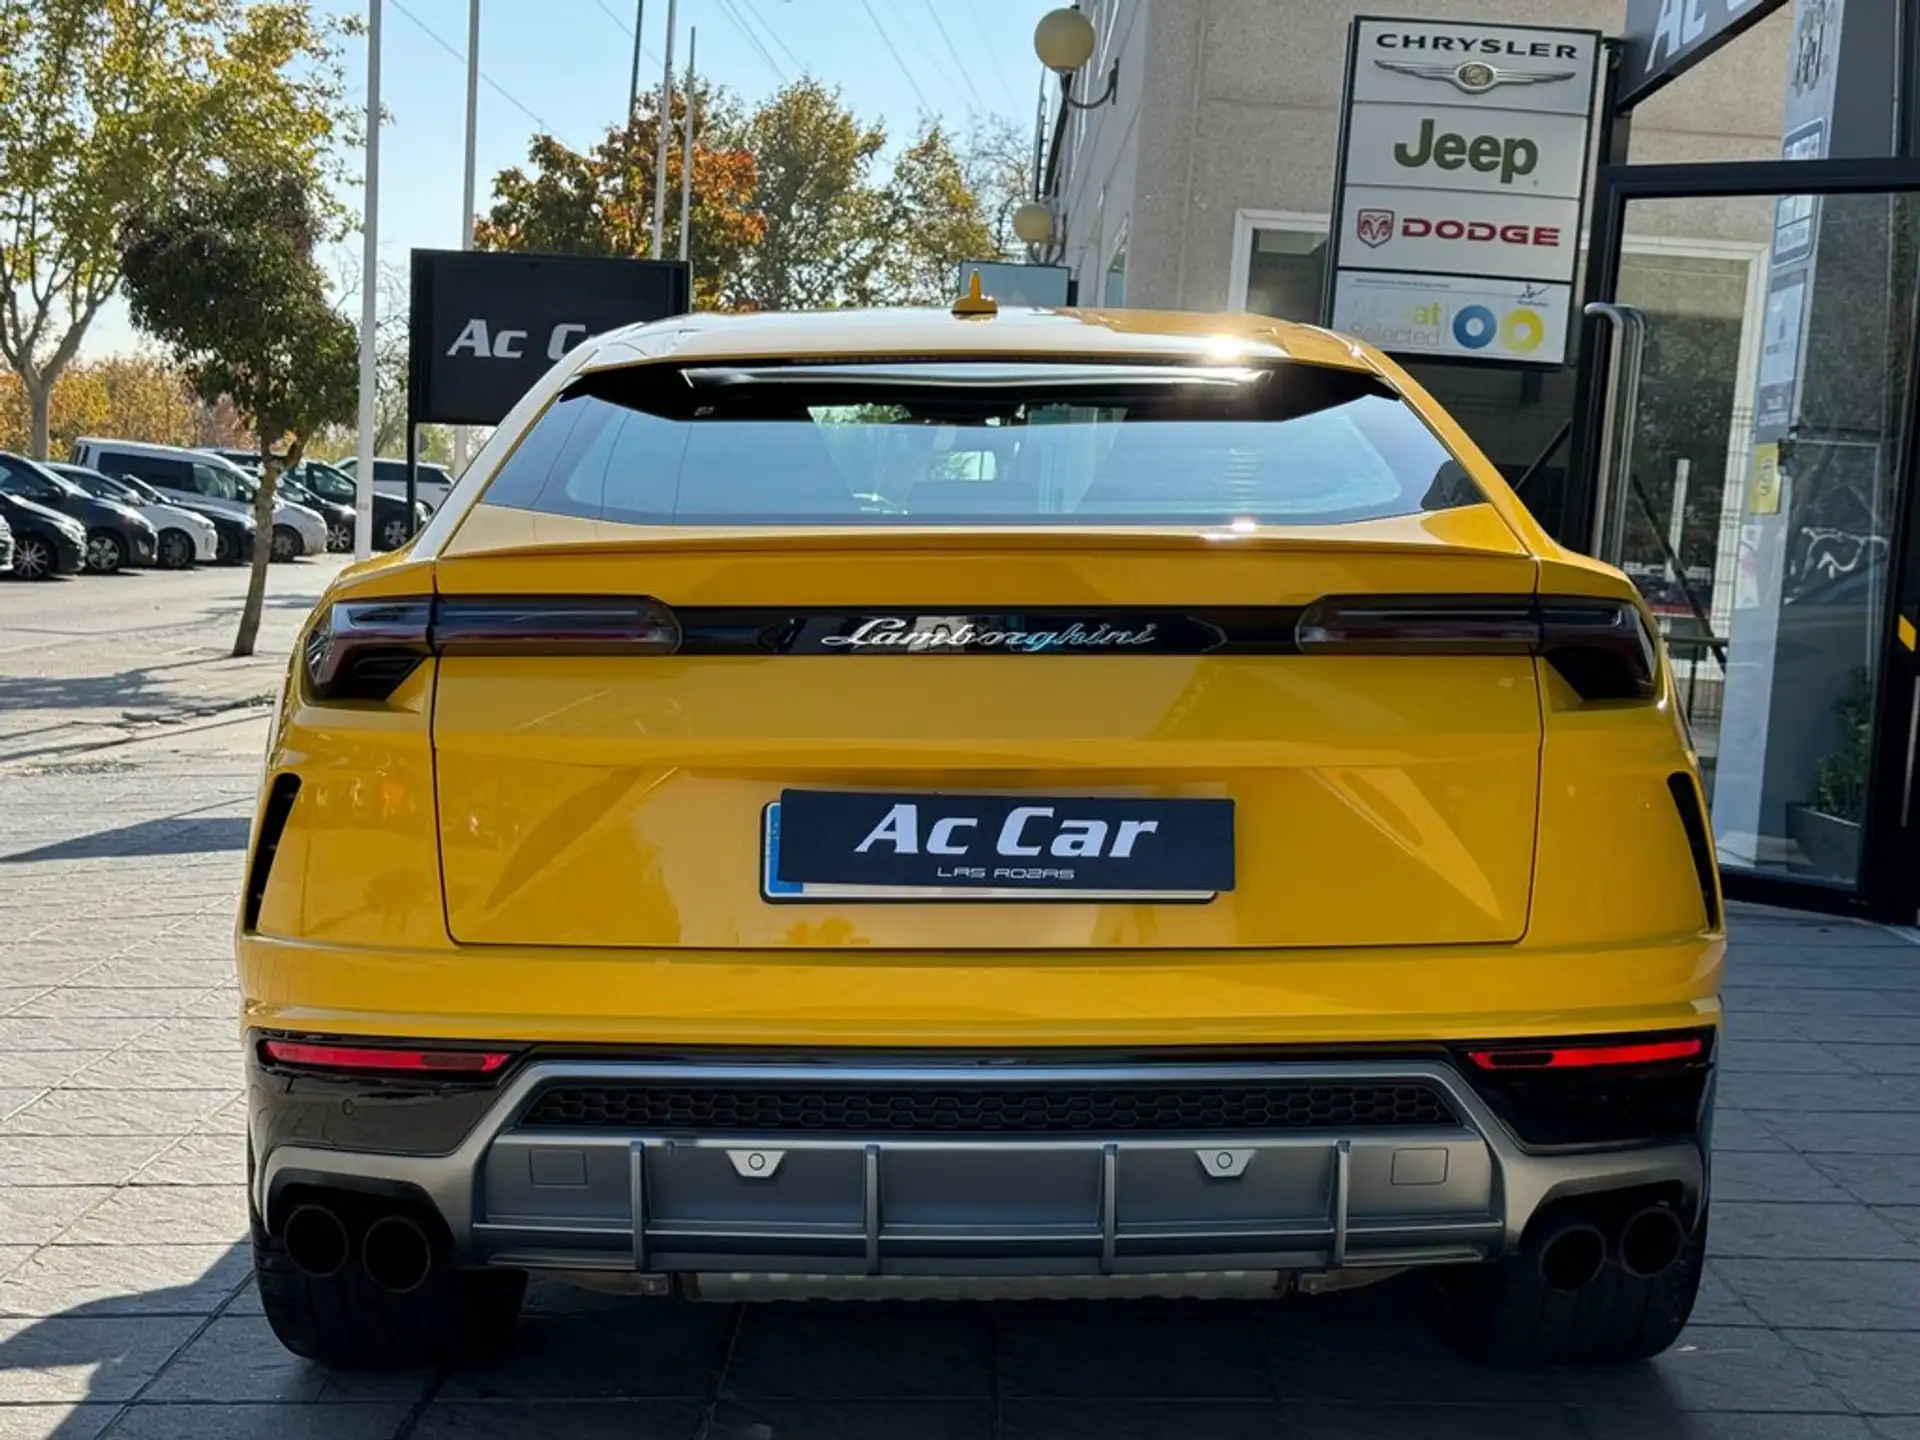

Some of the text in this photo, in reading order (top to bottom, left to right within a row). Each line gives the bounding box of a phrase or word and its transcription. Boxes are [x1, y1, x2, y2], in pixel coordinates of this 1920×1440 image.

[1376, 33, 1578, 59] CHRYSLER
[1394, 119, 1538, 184] Jeep
[1402, 218, 1560, 247] DODGE
[446, 318, 527, 359] Ac
[821, 617, 1157, 652] Lamborghini
[854, 803, 1159, 858] Ac Car
[937, 866, 987, 879] LAS
